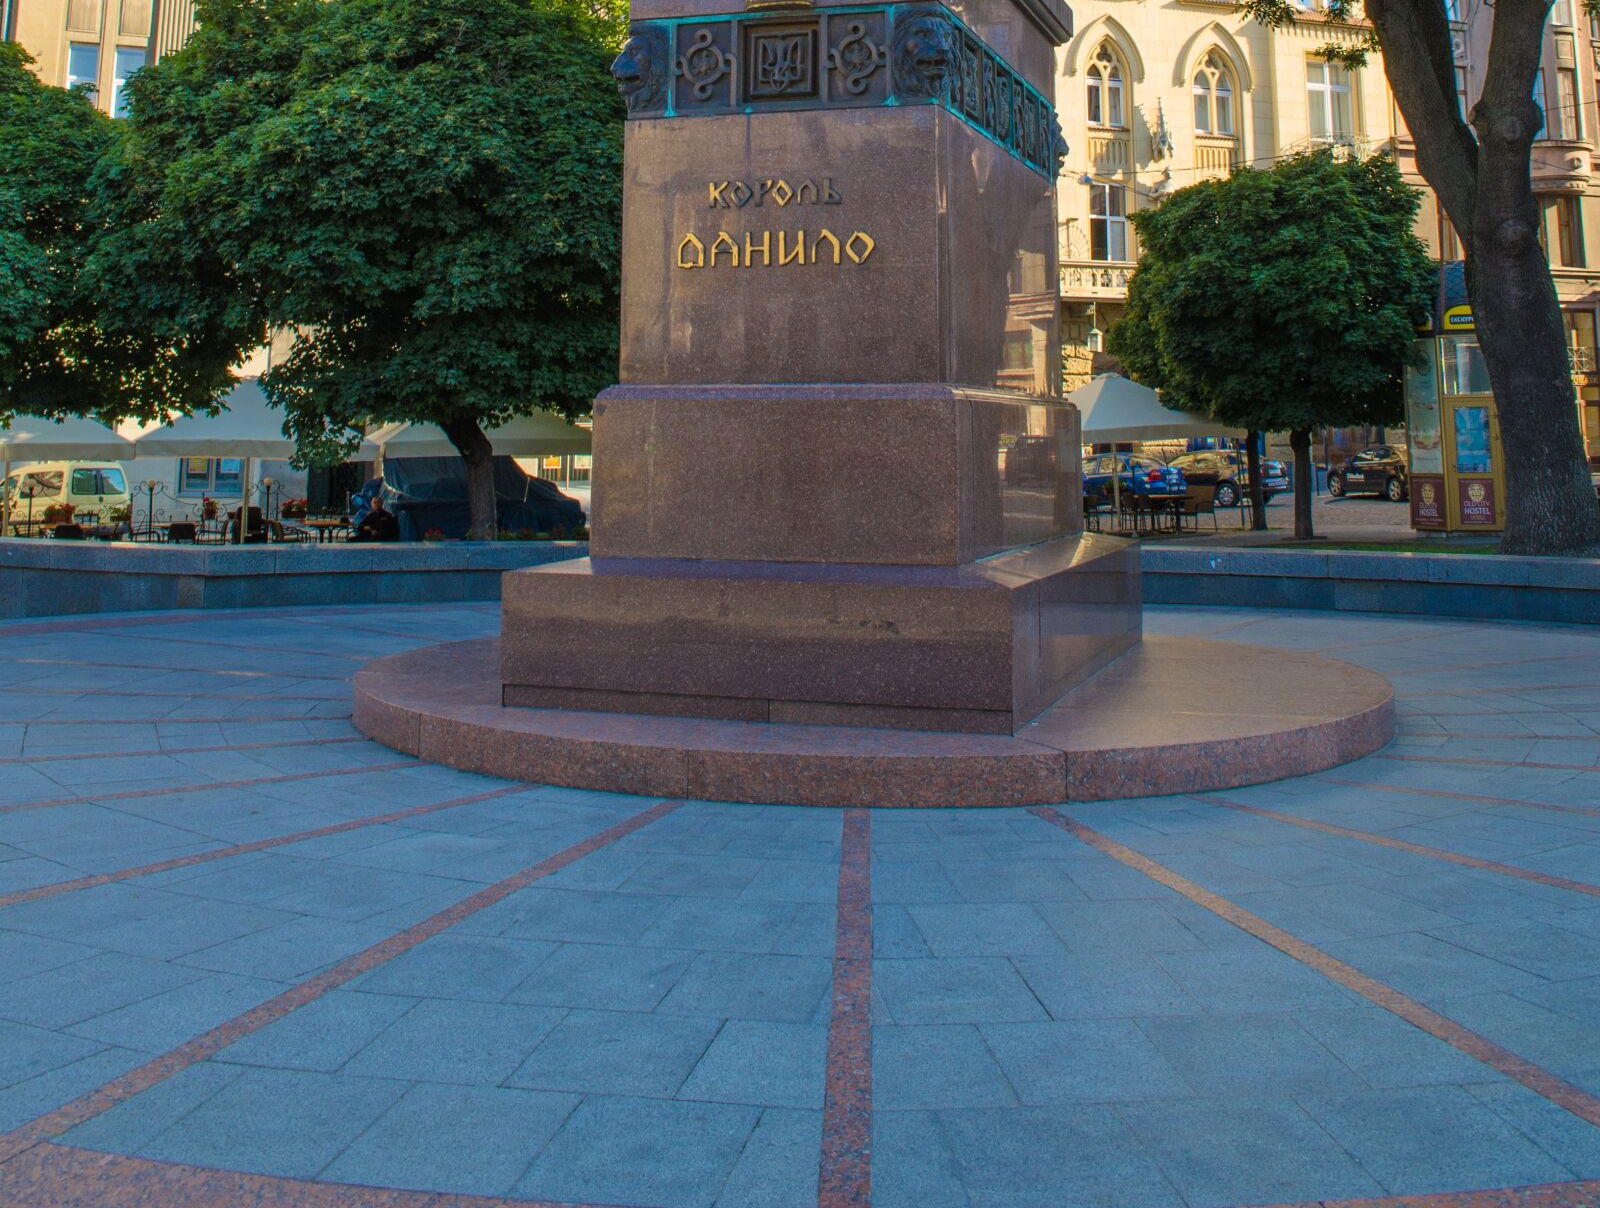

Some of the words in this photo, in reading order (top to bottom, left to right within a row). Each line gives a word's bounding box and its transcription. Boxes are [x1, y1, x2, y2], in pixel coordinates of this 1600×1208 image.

[677, 228, 876, 269] ДАНИЛО
[1419, 508, 1439, 517] HOSTEL
[1464, 507, 1491, 515] HOSTEL
